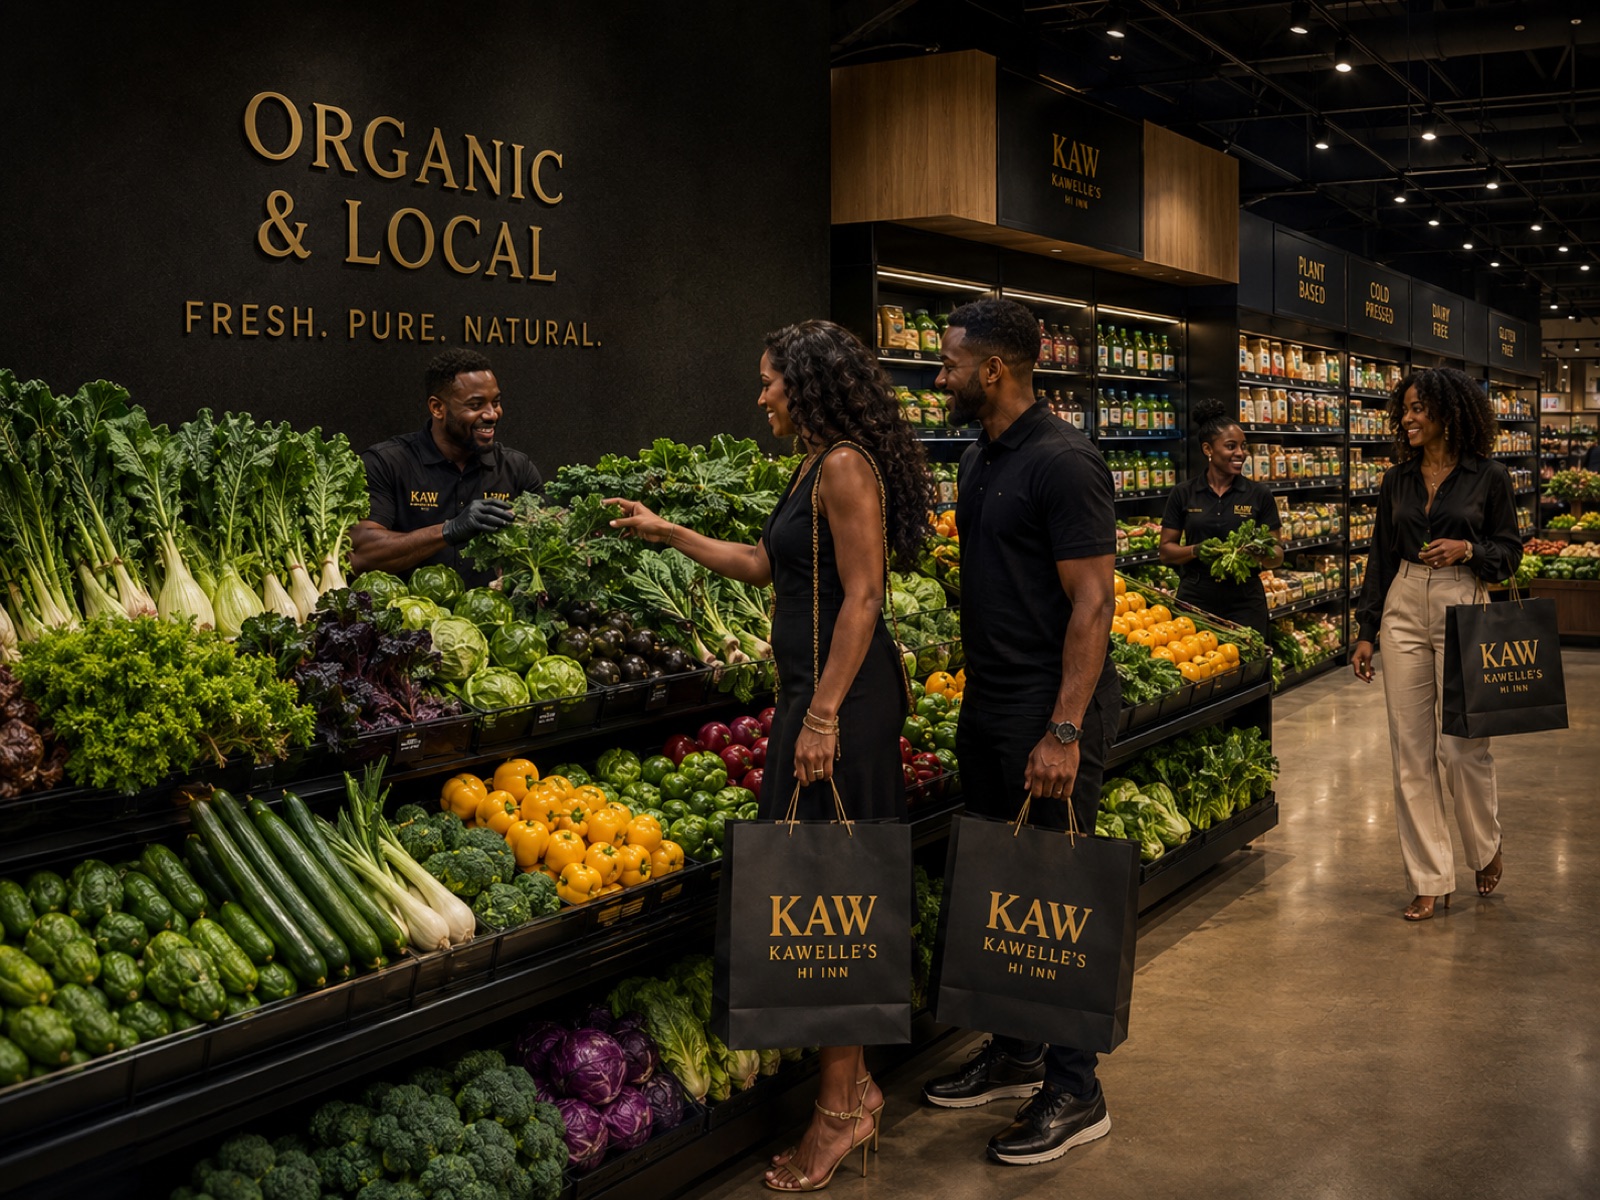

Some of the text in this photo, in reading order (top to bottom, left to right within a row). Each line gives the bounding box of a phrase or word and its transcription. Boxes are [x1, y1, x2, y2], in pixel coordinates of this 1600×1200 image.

[243, 91, 564, 206] ORGANIC
[1051, 133, 1100, 178] KAW
[1051, 172, 1102, 200] KAWELLE'S
[1064, 194, 1074, 205] HI
[256, 189, 558, 282] & LOCAL
[1297, 255, 1326, 283] PLANT
[1298, 280, 1327, 305] BASED
[1369, 281, 1391, 304] COLD
[184, 300, 603, 348] FRESH. PURE. NATURAL.
[1365, 301, 1395, 326] PRESSED
[1431, 302, 1451, 323] DAIRY
[1432, 321, 1450, 340] FREE
[1501, 342, 1516, 358] FREE
[410, 490, 439, 503] KAW
[1479, 639, 1539, 669] KAW
[1482, 669, 1543, 684] KAWELLE'S
[1499, 684, 1528, 694] HI INN
[768, 895, 877, 937] KAW
[986, 891, 1093, 944] KAW
[768, 943, 879, 961] KAWELLE'S
[982, 936, 1087, 969] KAWELLE'S
[796, 966, 850, 979] HI INN
[1007, 962, 1058, 981] HI INN
